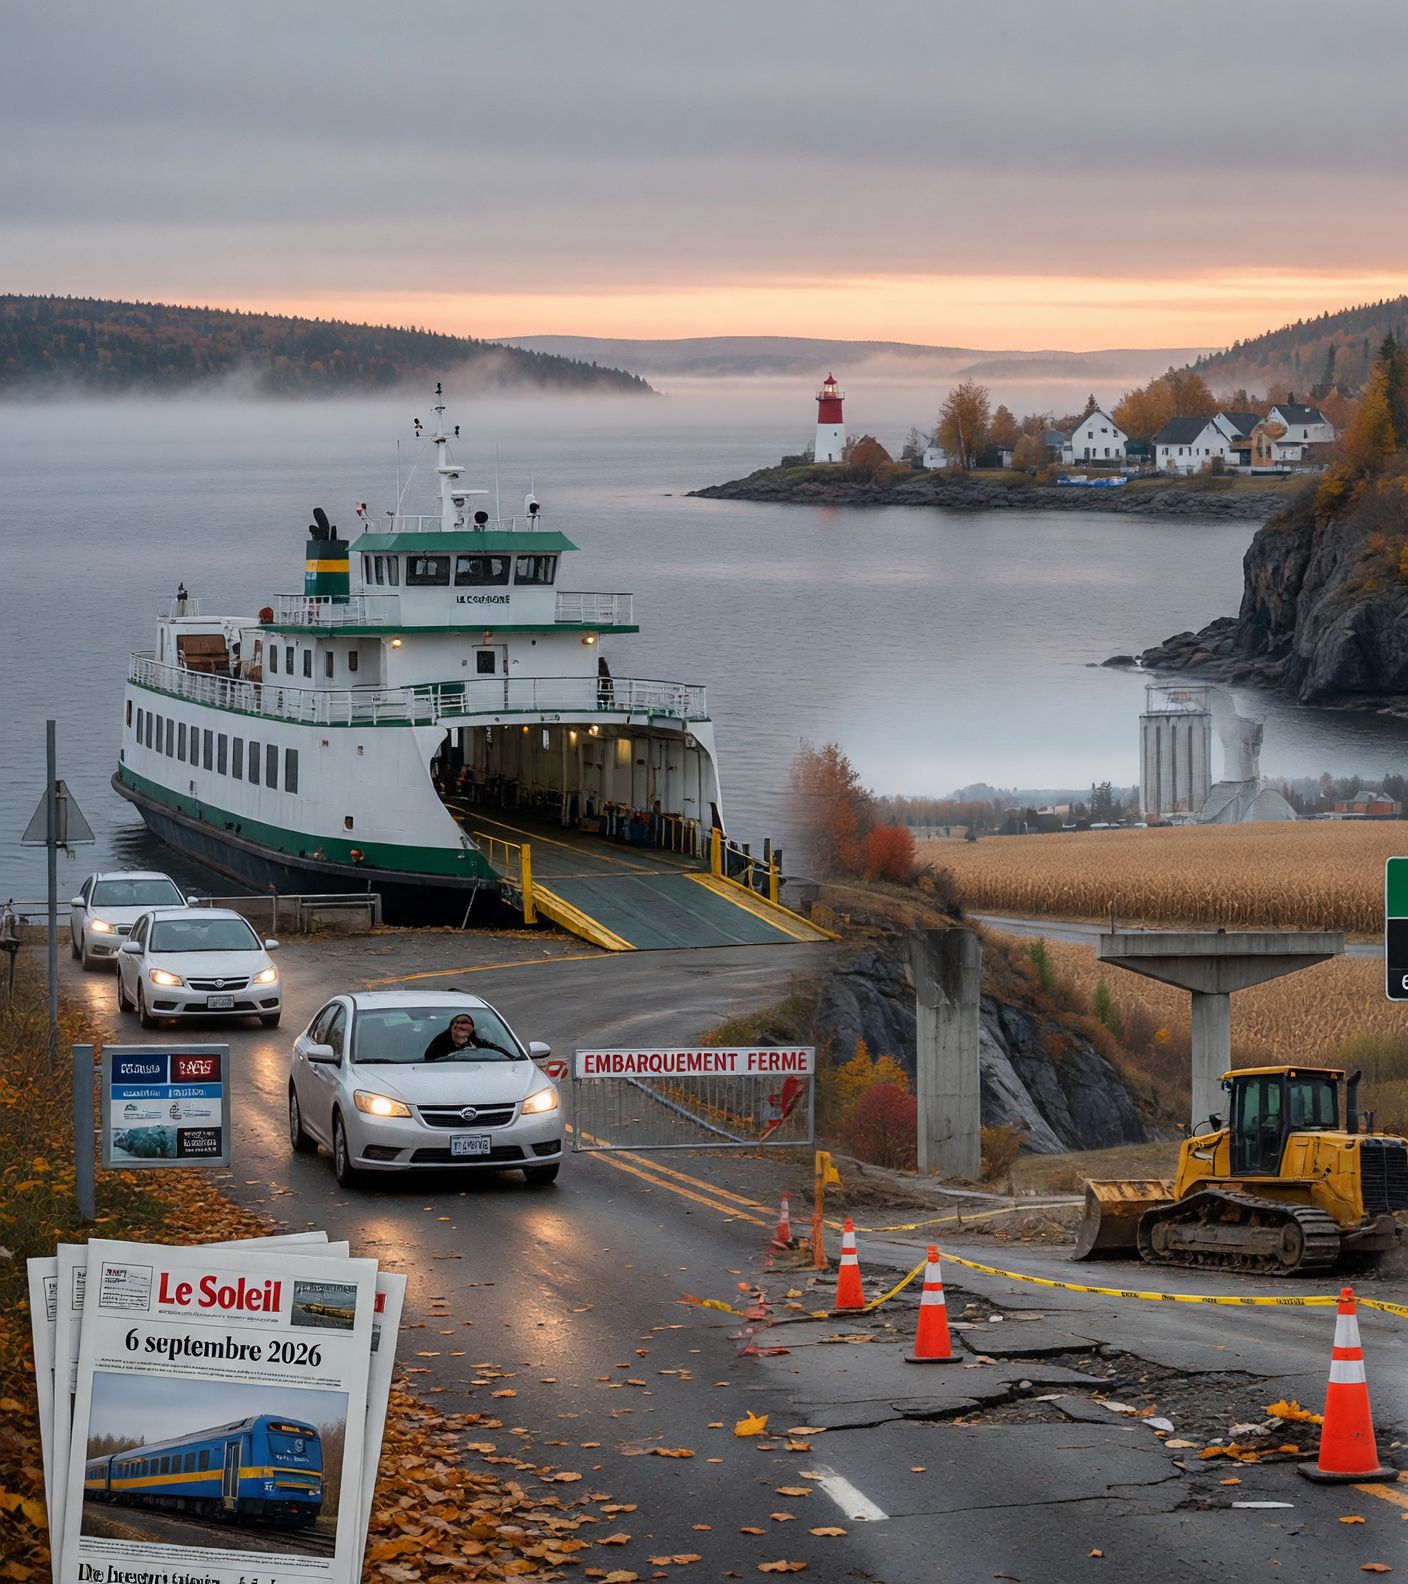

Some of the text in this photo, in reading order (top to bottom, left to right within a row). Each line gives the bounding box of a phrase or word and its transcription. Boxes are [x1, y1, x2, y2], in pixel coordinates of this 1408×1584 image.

[584, 1052, 738, 1074] EMBARQUEMENT
[158, 1272, 194, 1306] Le
[198, 1275, 283, 1313] Soleil
[125, 1327, 322, 1368] 6 septembre 2026
